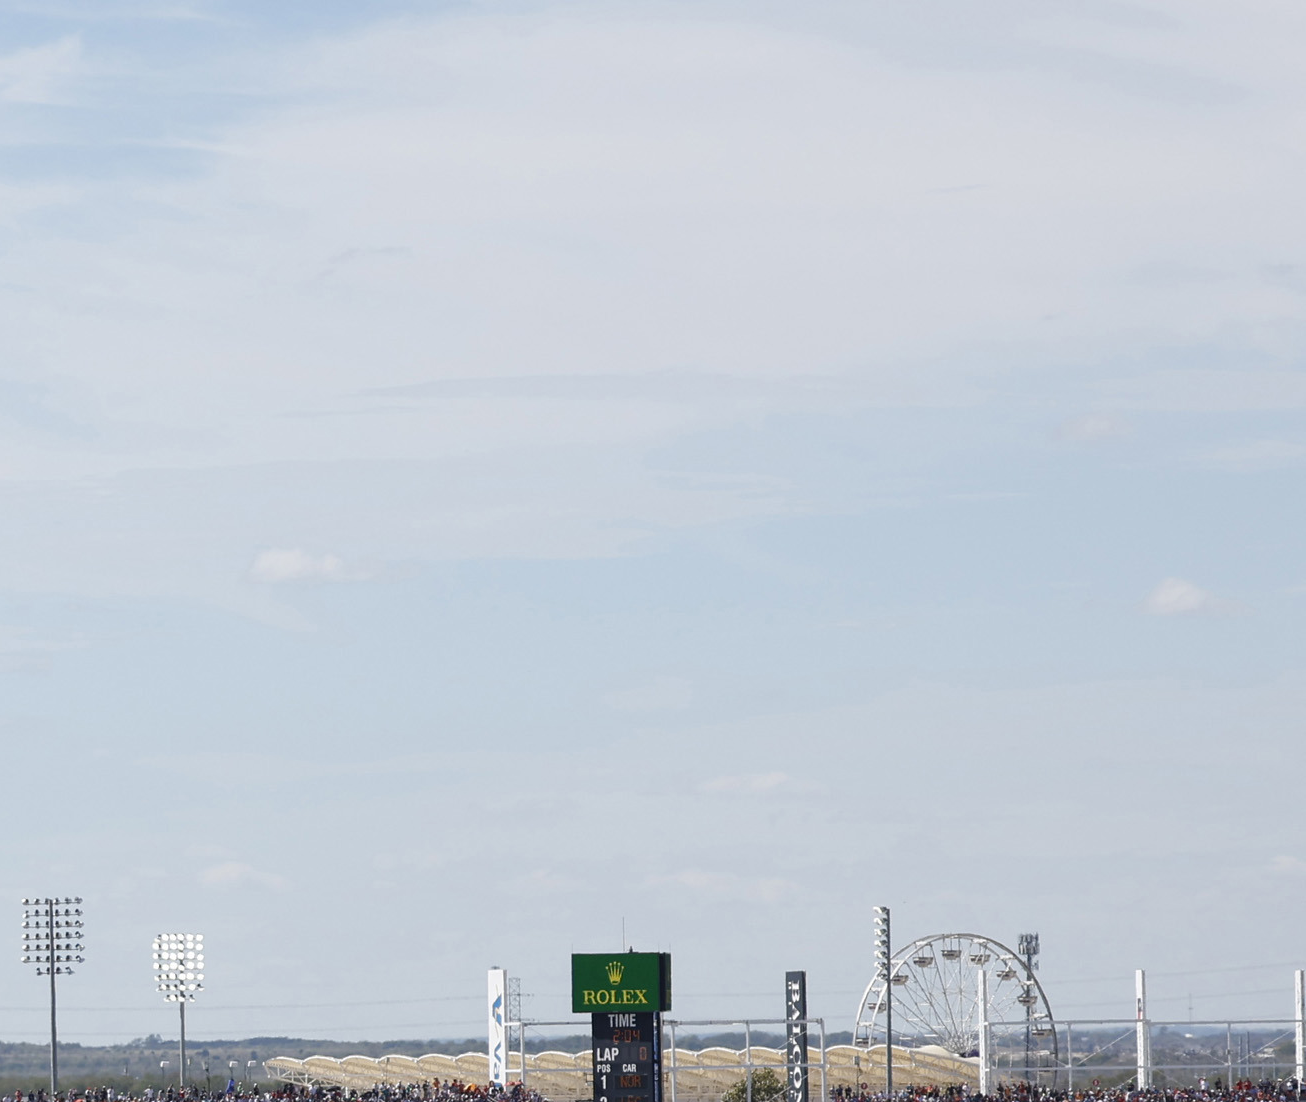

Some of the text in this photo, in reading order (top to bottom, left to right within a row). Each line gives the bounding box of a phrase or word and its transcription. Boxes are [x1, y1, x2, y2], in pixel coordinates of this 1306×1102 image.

[582, 989, 649, 1005] ROLEX
[608, 1013, 636, 1028] TIME
[613, 1029, 641, 1044] 2:04
[596, 1046, 647, 1062] LAP 0
[597, 1063, 637, 1073] POS CAR
[600, 1075, 607, 1090] 1
